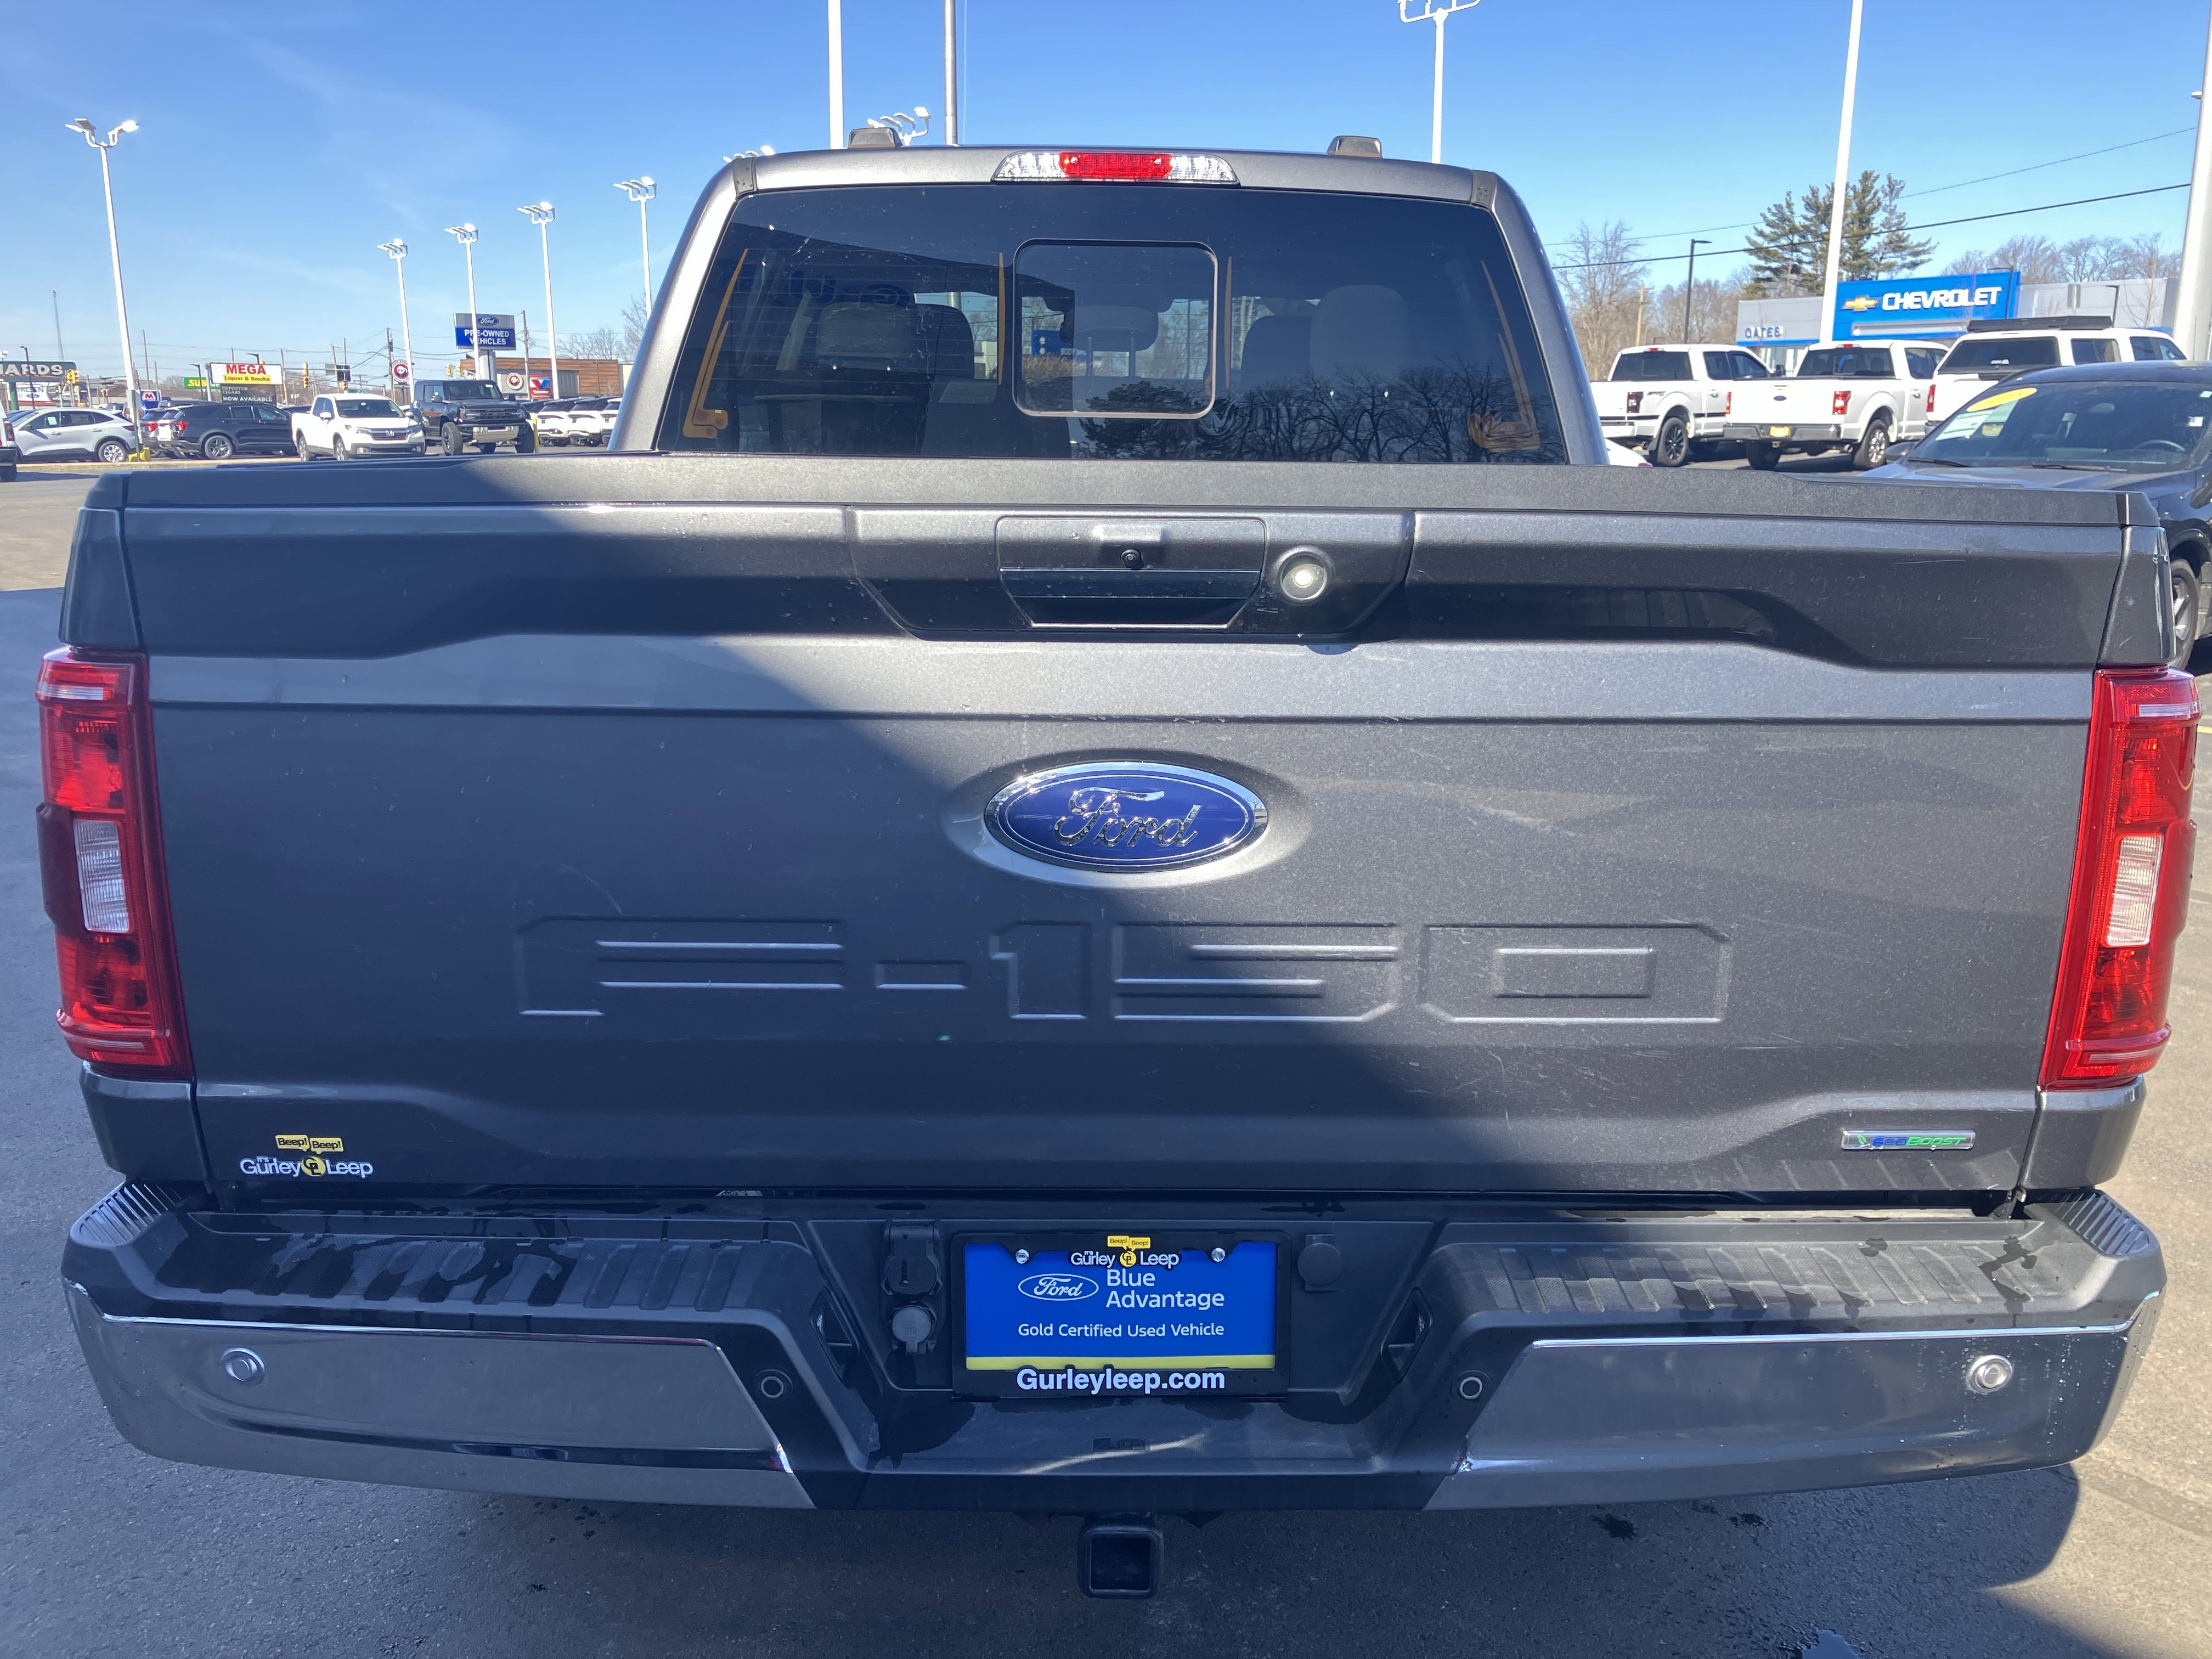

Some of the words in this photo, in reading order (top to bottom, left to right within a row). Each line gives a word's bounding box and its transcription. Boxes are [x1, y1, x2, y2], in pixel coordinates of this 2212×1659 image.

[1882, 286, 2002, 311] CHEVROLET
[464, 329, 509, 337] PRE-OWNED
[226, 364, 267, 375] MEGA
[1053, 786, 1202, 848] Ford
[516, 917, 1734, 1024] F-150
[278, 1137, 307, 1147] Beep!
[312, 1141, 341, 1150] Beep!
[240, 1158, 301, 1177] Gurley
[325, 1159, 374, 1178] Leep
[1070, 1251, 1115, 1268] Gurley
[1140, 1251, 1180, 1269] Leep
[1033, 1277, 1082, 1297] Ford
[1107, 1269, 1155, 1287] Blue
[1106, 1290, 1225, 1311] Advantage
[1018, 1323, 1053, 1336] Gold
[1058, 1323, 1122, 1337] Certified
[1127, 1324, 1166, 1337] Used
[1170, 1323, 1224, 1336] Vehicle
[1017, 1368, 1226, 1395] Gurleyleep.com
